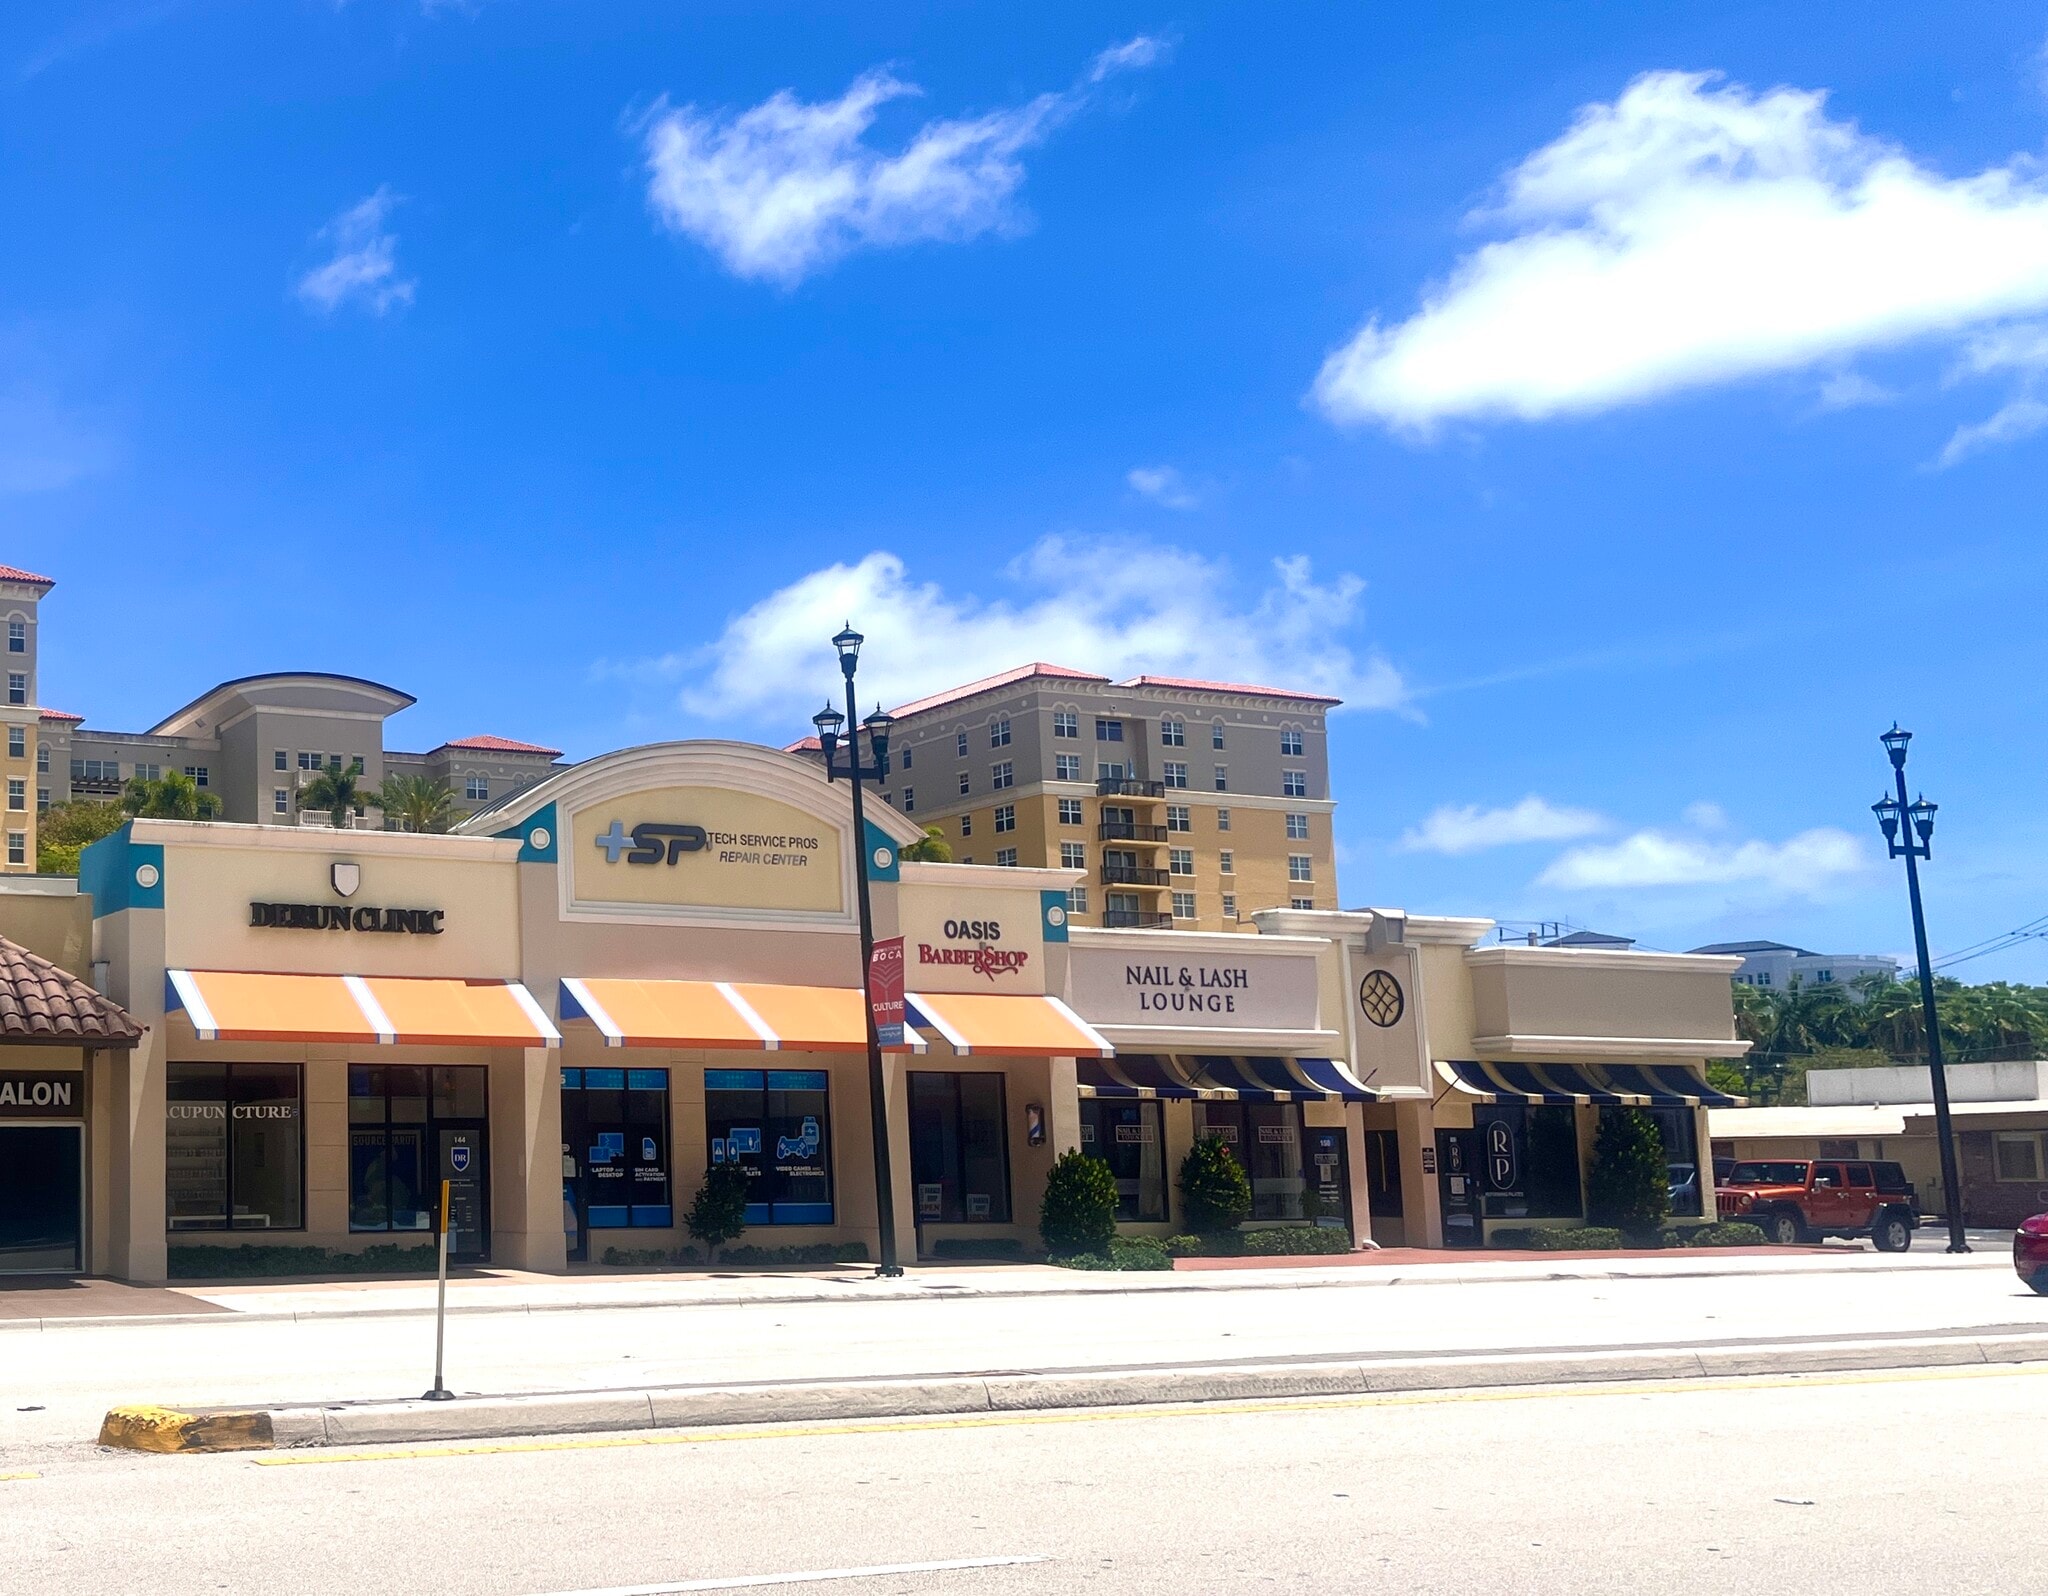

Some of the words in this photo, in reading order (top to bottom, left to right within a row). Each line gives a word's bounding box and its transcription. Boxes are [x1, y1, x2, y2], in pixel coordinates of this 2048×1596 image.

[707, 832, 737, 845] TECH
[740, 834, 786, 848] SERVICE
[788, 837, 819, 850] PROS
[719, 851, 760, 864] REPAIR
[763, 853, 808, 867] CENTER
[249, 902, 353, 931] DERUN
[352, 907, 445, 935] CLINIC
[944, 920, 1001, 940] OASIS
[872, 950, 902, 962] BOCA
[1126, 966, 1174, 986] NAIL
[1179, 967, 1195, 987] &
[1199, 968, 1248, 988] LASH
[873, 1001, 904, 1012] CULTURE
[1140, 992, 1235, 1013] LOUNGE
[454, 1136, 466, 1144] 144
[1494, 1130, 1508, 1152] R
[454, 1154, 467, 1162] DR
[1496, 1158, 1510, 1181] P
